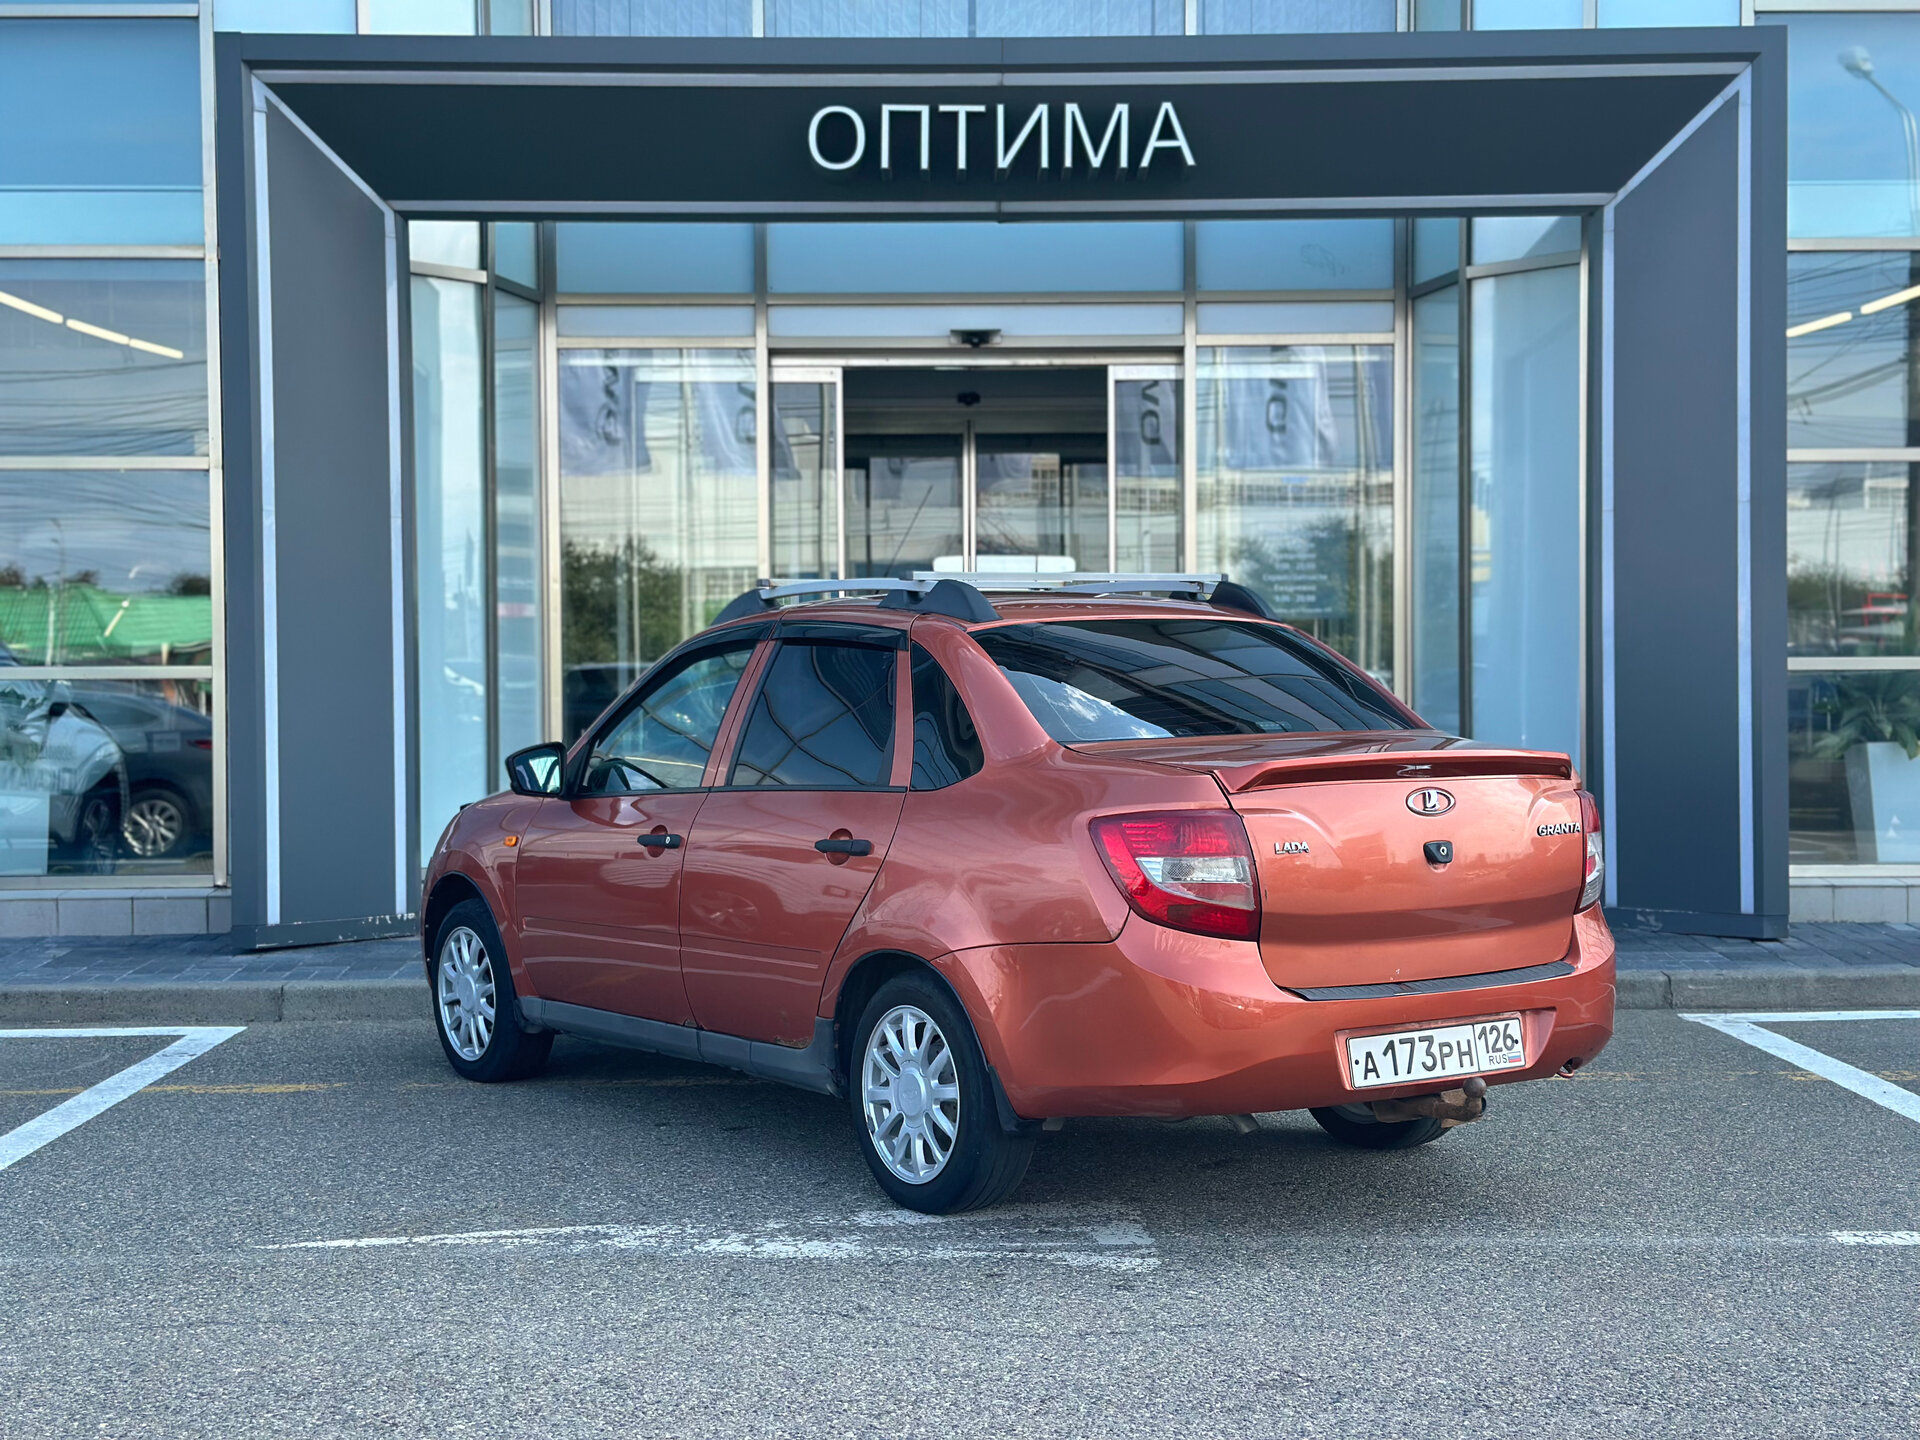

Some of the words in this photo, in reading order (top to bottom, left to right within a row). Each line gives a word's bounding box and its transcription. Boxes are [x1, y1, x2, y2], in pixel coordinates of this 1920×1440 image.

[808, 102, 1196, 170] ОПТИМА
[1537, 822, 1581, 836] GRANTA
[1274, 841, 1310, 855] LADA
[1477, 1022, 1515, 1054] 126
[1489, 1053, 1508, 1066] RUS
